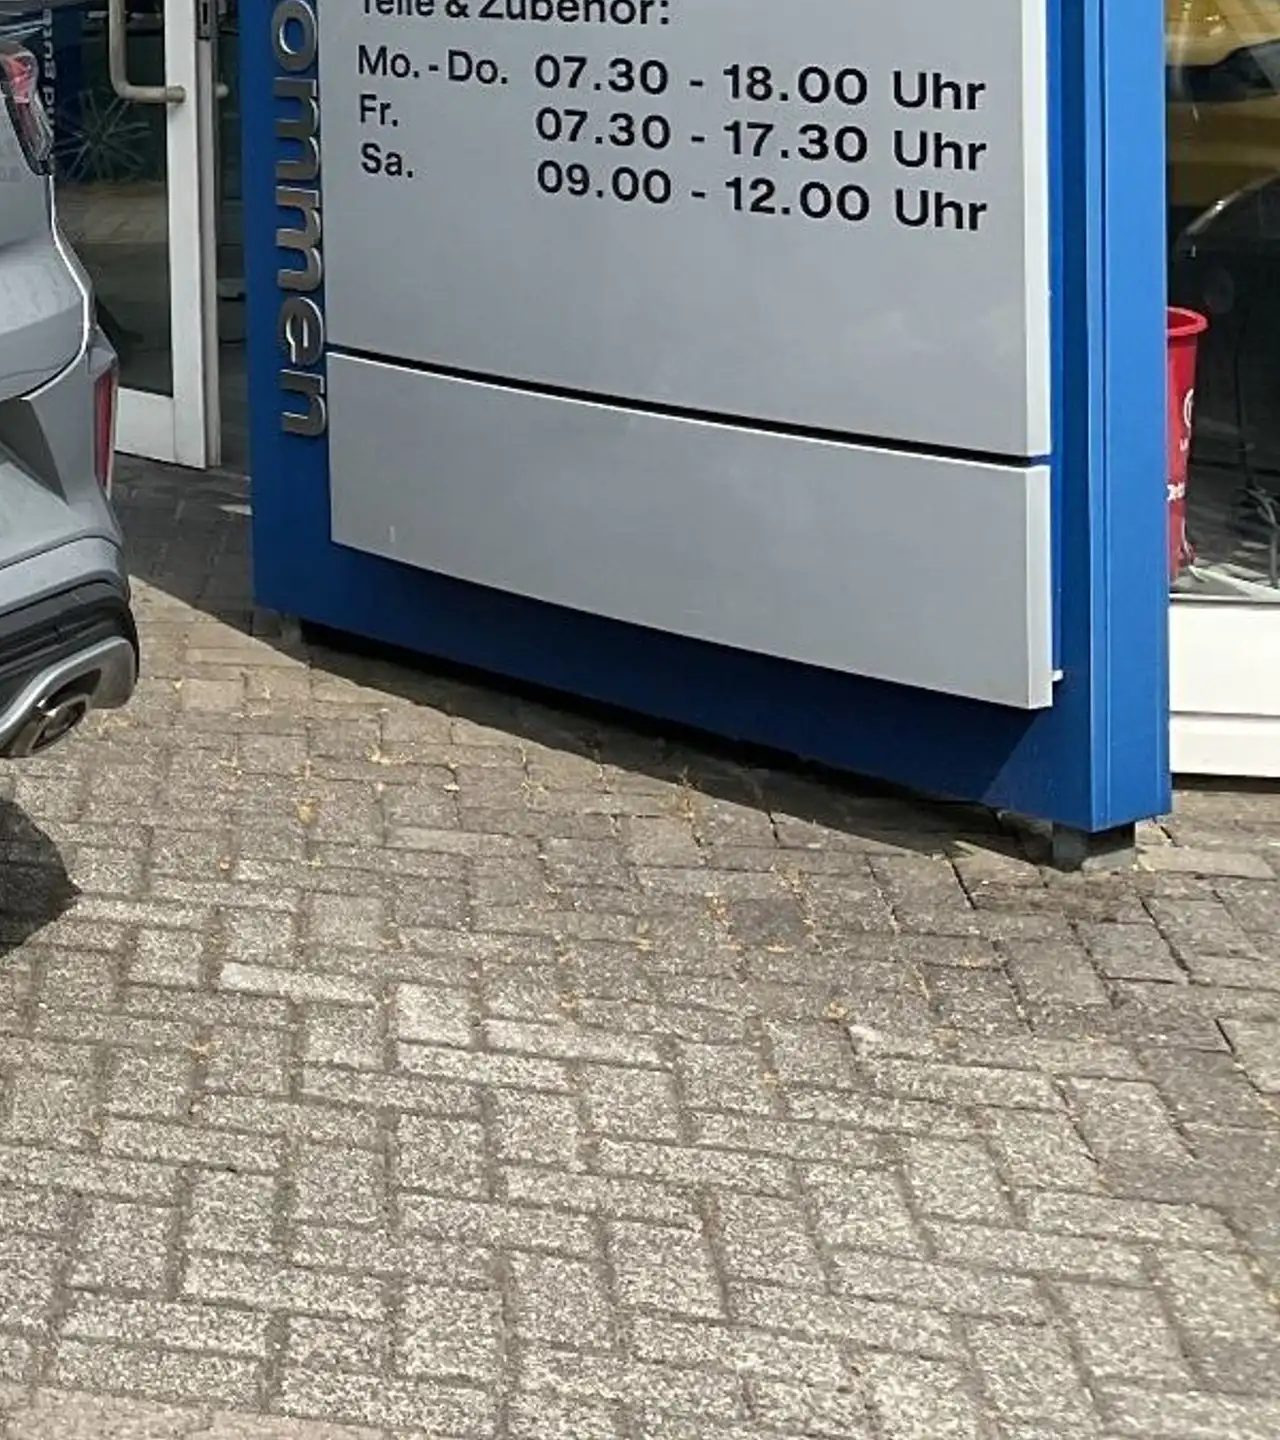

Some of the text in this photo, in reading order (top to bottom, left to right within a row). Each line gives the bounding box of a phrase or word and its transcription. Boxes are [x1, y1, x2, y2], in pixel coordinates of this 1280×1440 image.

[535, 54, 669, 95] 07.30
[722, 63, 868, 106] 18.00
[893, 70, 987, 111] Uhr
[359, 93, 399, 128] Fr.
[535, 106, 671, 150] 07.30
[723, 120, 868, 163] 17.30
[893, 130, 987, 171] Uhr
[361, 142, 413, 179] Sa.
[537, 159, 672, 204] 09.00
[725, 176, 870, 222] 12.00
[895, 188, 988, 232] Uhr
